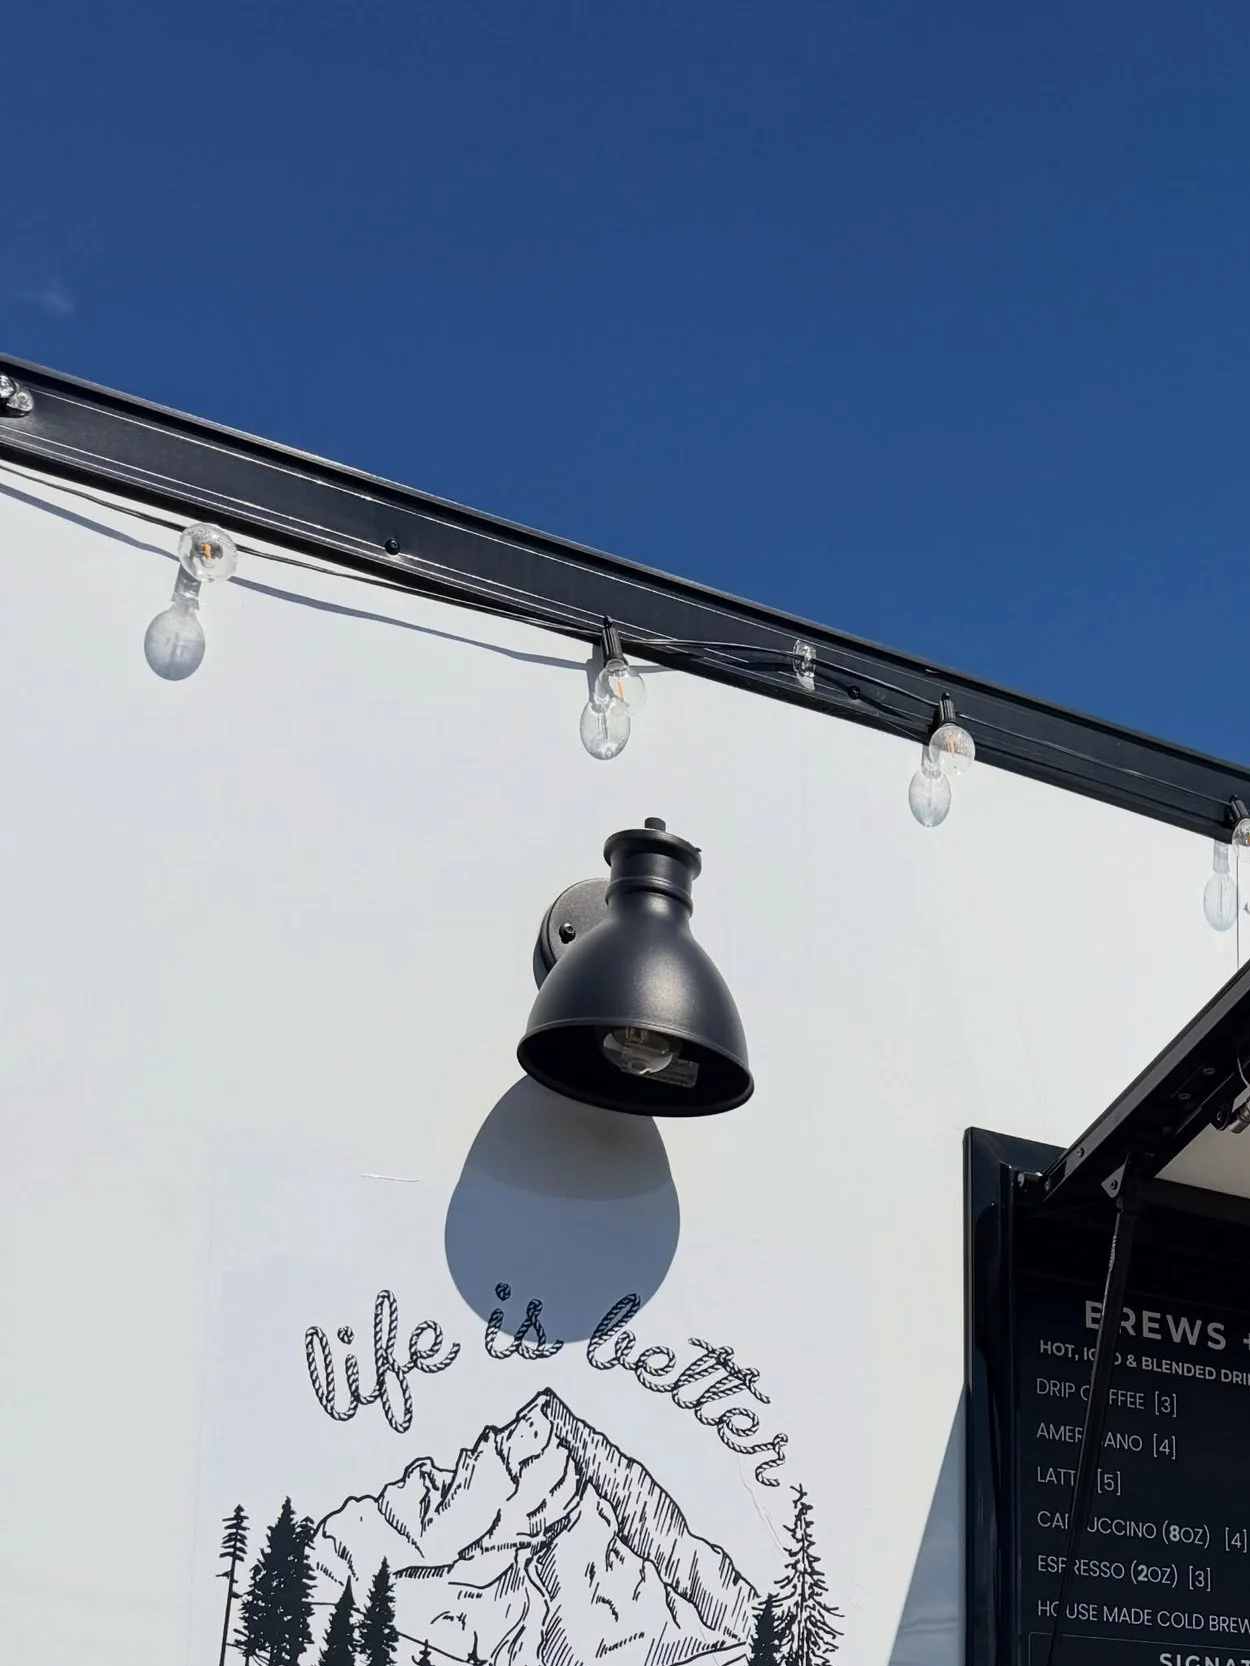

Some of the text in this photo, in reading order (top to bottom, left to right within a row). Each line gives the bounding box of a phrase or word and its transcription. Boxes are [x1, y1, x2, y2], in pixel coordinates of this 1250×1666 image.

[1040, 1340, 1079, 1361] HOT,
[1126, 1354, 1137, 1367] &
[1142, 1356, 1216, 1380] BLENDED
[304, 1282, 790, 1488] life is better
[1037, 1378, 1177, 1418] DRIP CFFEE [3]
[1153, 1433, 1176, 1460] [4]
[1036, 1466, 1122, 1496] LATT [5]
[1162, 1520, 1210, 1549] (8OZ)
[1225, 1527, 1247, 1553] [4]
[1131, 1560, 1178, 1588] (2OZ)
[1189, 1565, 1211, 1592] [3]
[1103, 1606, 1152, 1625] MADE
[1157, 1611, 1204, 1630] COLD
